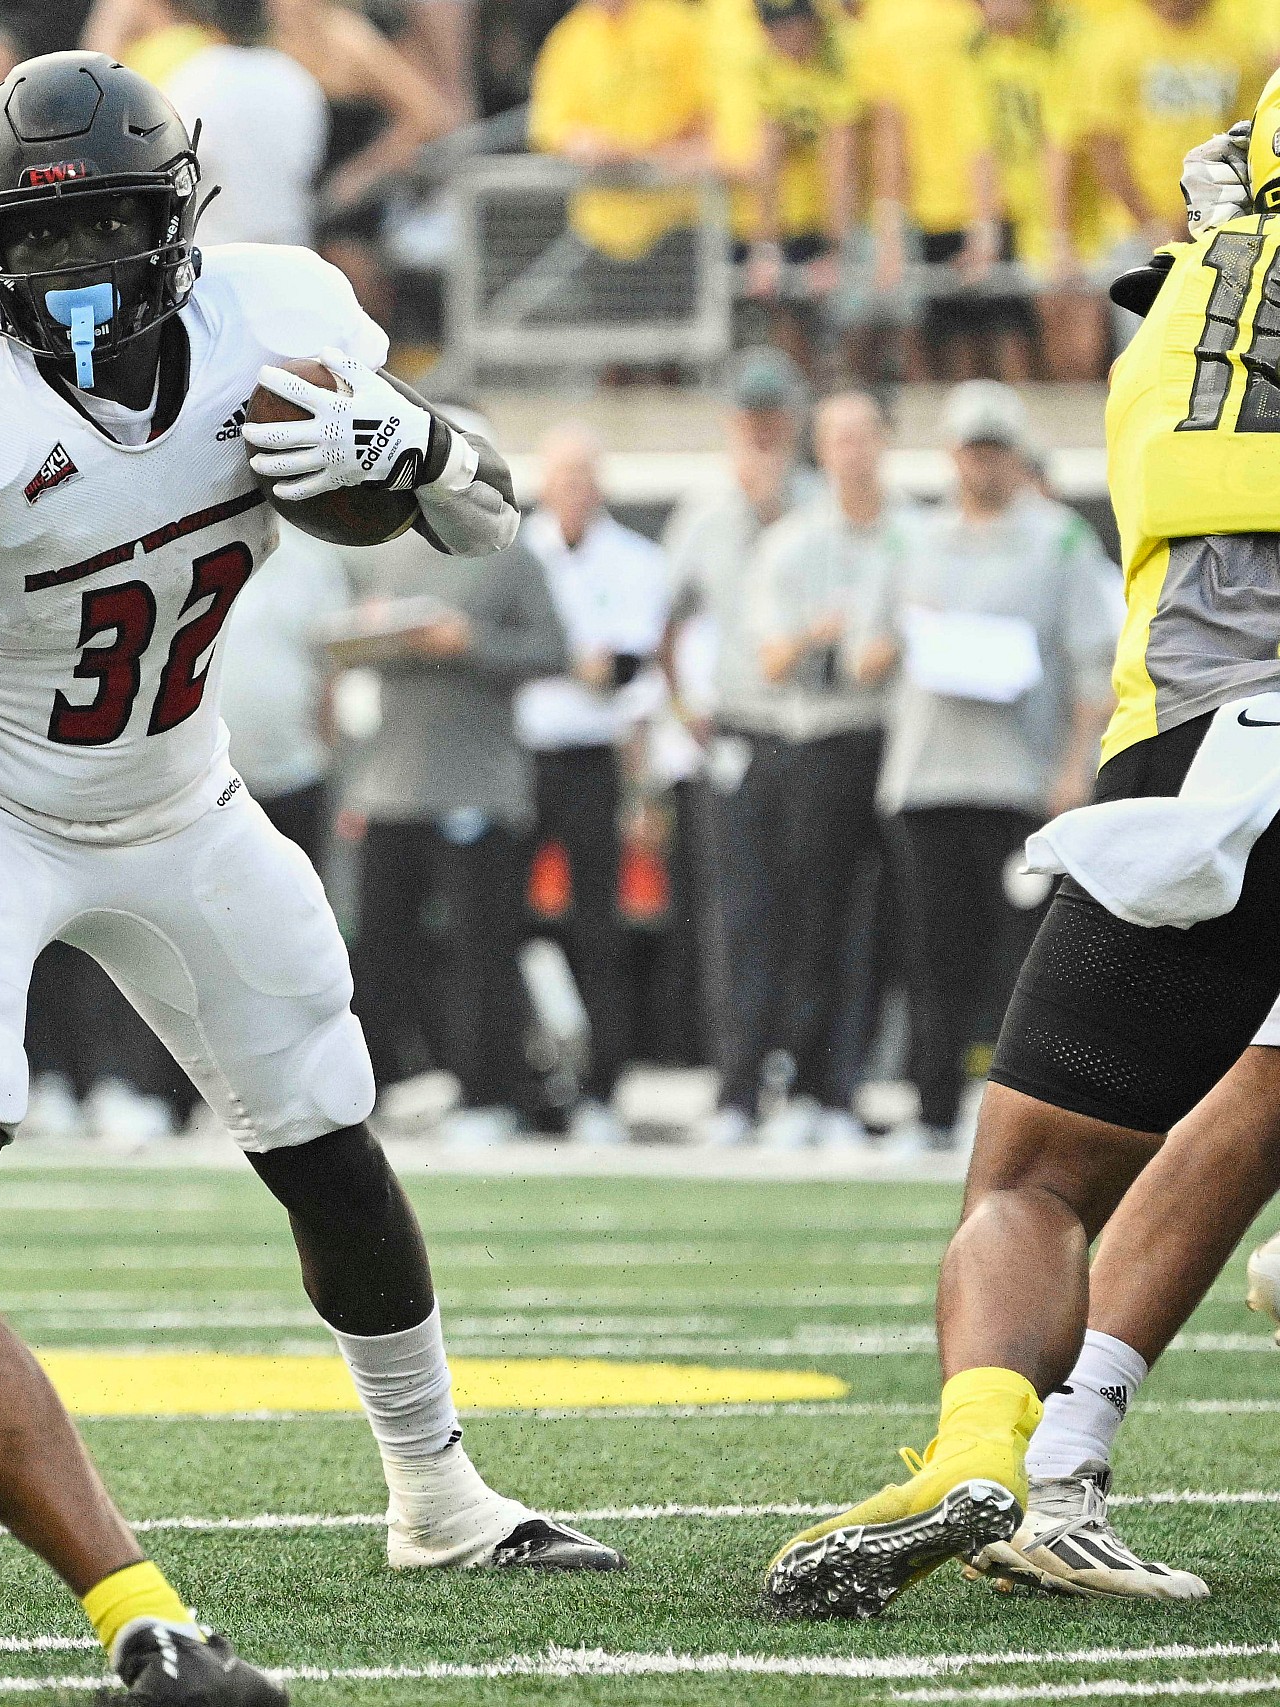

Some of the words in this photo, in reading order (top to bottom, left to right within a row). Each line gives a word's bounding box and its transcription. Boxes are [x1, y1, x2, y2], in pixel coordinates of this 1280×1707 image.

[216, 424, 243, 442] adi
[361, 415, 402, 471] adidas
[41, 445, 70, 481] SKY
[47, 540, 254, 746] 32
